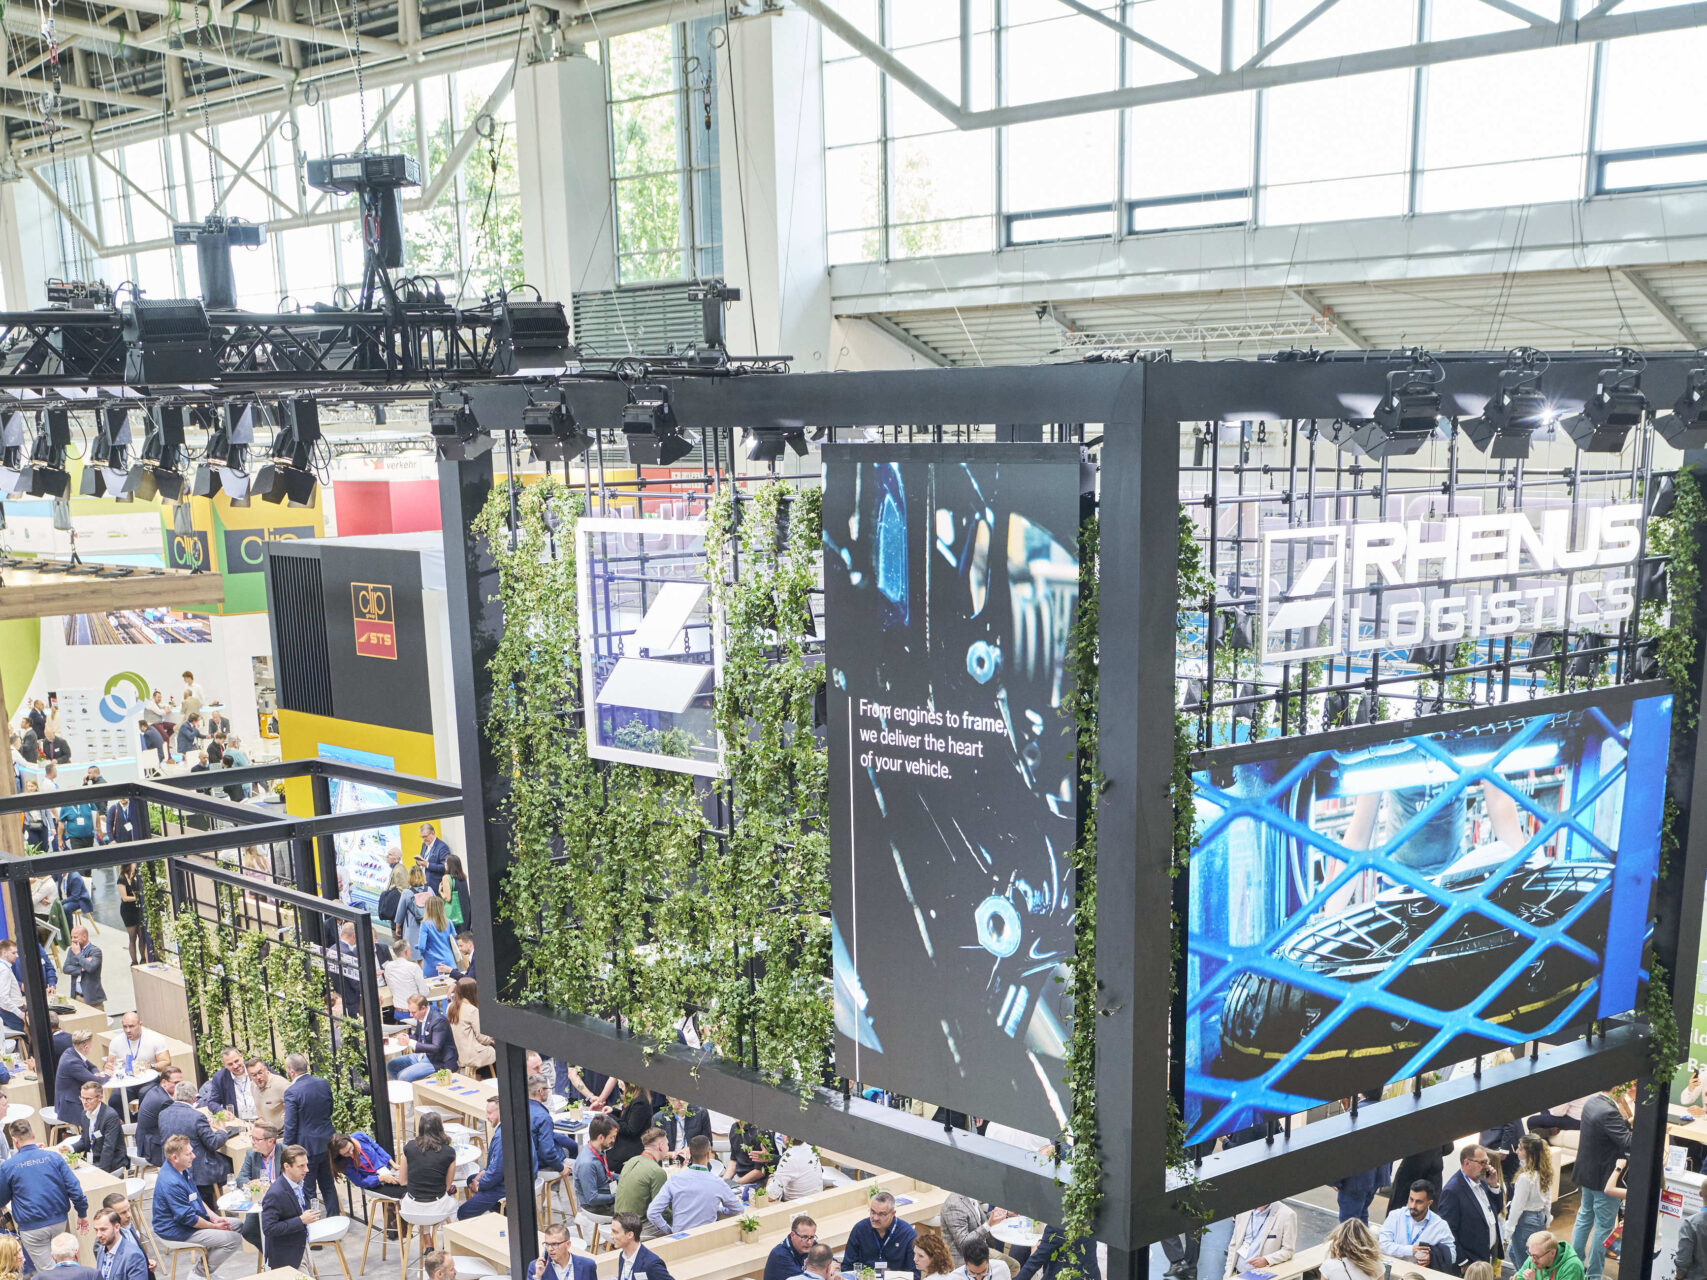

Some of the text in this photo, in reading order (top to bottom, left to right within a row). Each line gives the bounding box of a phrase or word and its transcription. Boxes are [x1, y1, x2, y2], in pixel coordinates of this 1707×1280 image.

[386, 461, 416, 470] verkehr
[1353, 504, 1642, 590] RHENUS
[358, 585, 385, 621] clip
[1349, 577, 1637, 652] LOGISTICS
[369, 632, 392, 646] STS
[859, 699, 1008, 737] From engines to frame,
[859, 728, 984, 758] we deliver the heart
[860, 751, 952, 780] of your vehicle.
